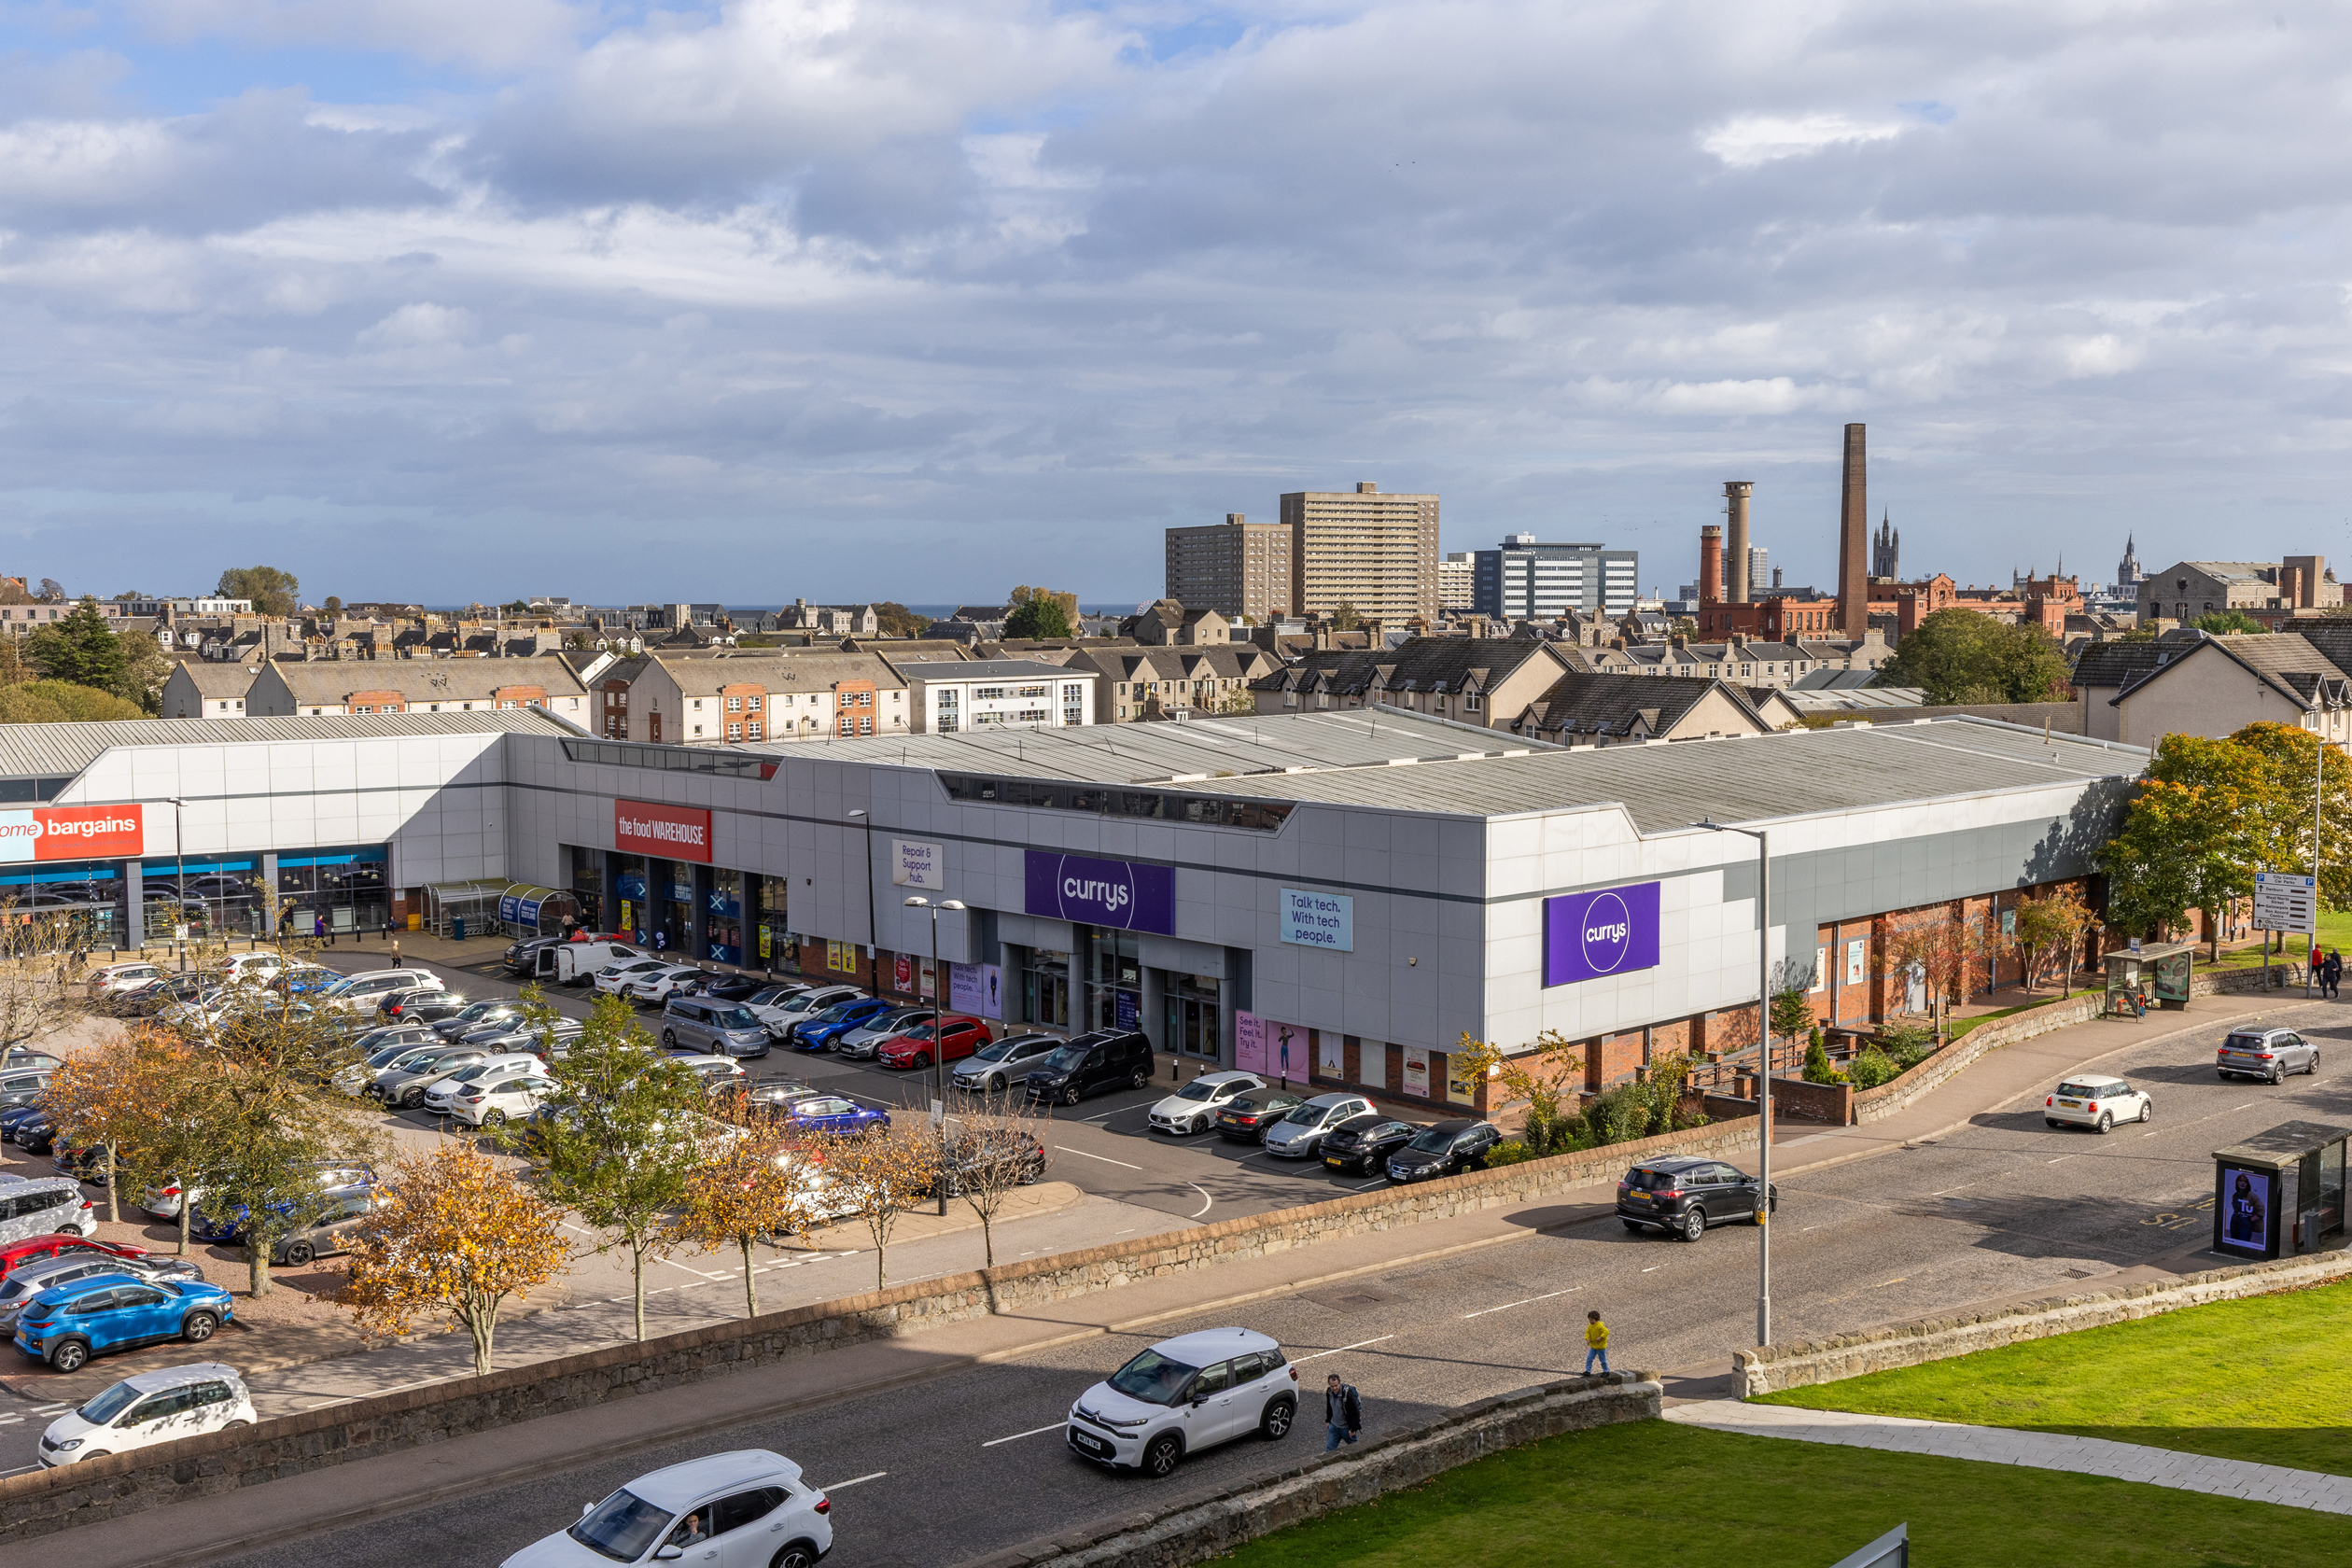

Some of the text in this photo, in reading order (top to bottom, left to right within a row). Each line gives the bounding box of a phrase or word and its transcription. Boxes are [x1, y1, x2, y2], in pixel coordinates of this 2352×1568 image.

[0, 816, 136, 838] ome bargains
[619, 816, 705, 846] the food WAREHOUSE
[903, 845, 931, 858] Repair &
[903, 858, 931, 872] Support
[909, 872, 925, 883] hub.
[1064, 877, 1128, 912] currys
[1291, 894, 1341, 913] Talk tech.
[1292, 910, 1339, 929] With tech
[1295, 929, 1336, 945] people.
[1587, 922, 1627, 944] currys
[953, 962, 978, 974] Talk tech.
[953, 972, 978, 984] With tech
[953, 983, 973, 992] people.
[1239, 1015, 1253, 1027] See
[1239, 1027, 1263, 1039] Feel it.
[1239, 1037, 1250, 1049] Try
[2237, 1198, 2254, 1213] Tu
